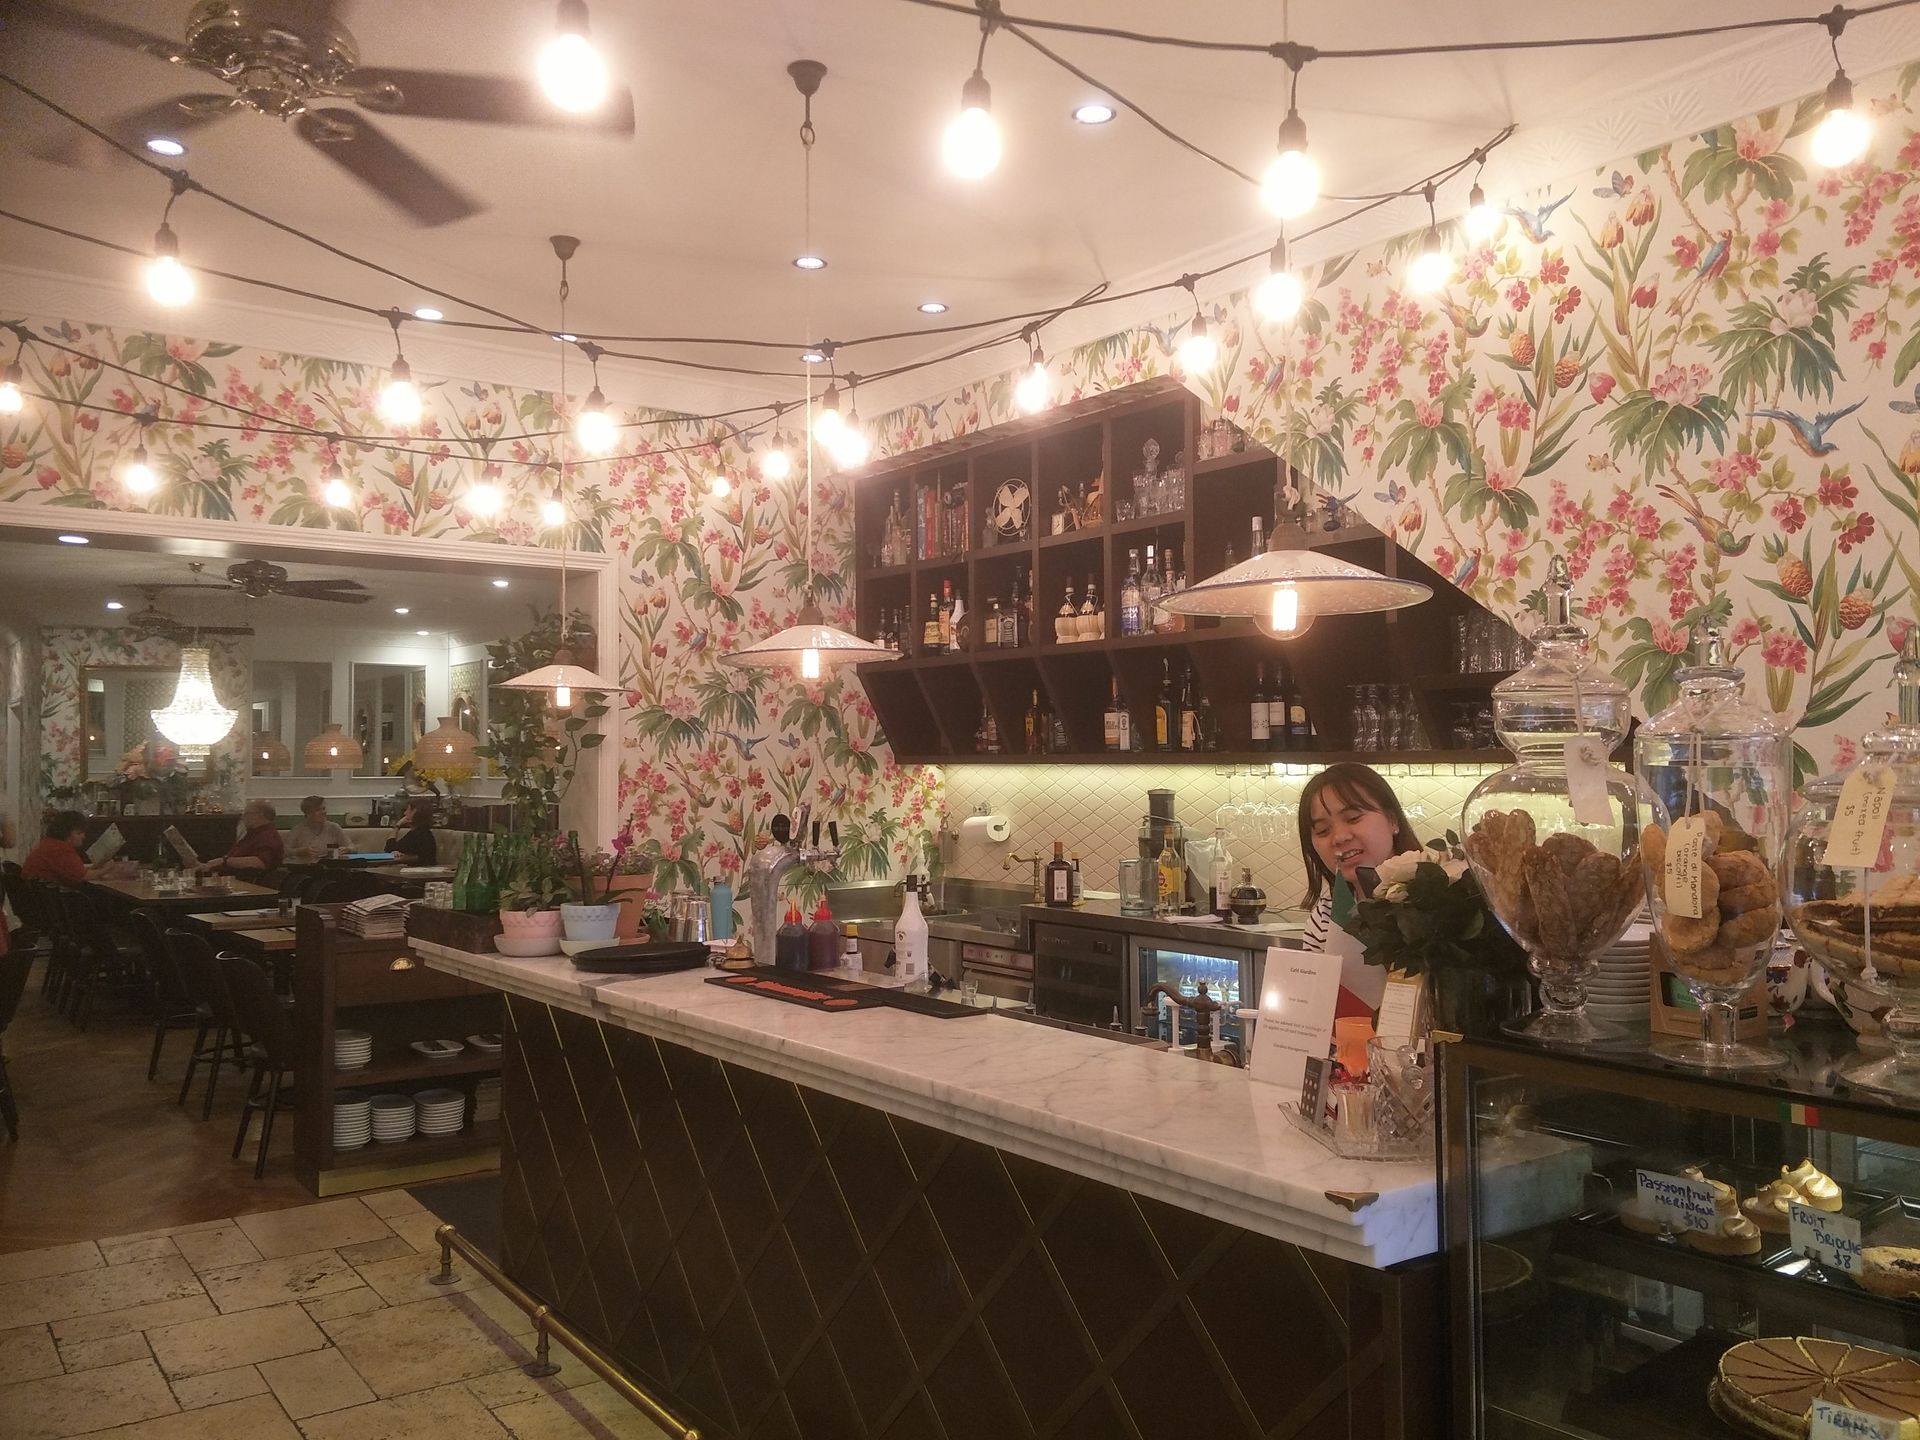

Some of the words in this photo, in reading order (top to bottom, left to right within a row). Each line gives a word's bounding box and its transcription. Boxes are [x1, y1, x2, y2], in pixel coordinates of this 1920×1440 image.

[1638, 1173, 1715, 1203] Passionfruit
[1684, 1211, 1708, 1230] $10
[1834, 1250, 1852, 1269] $8
